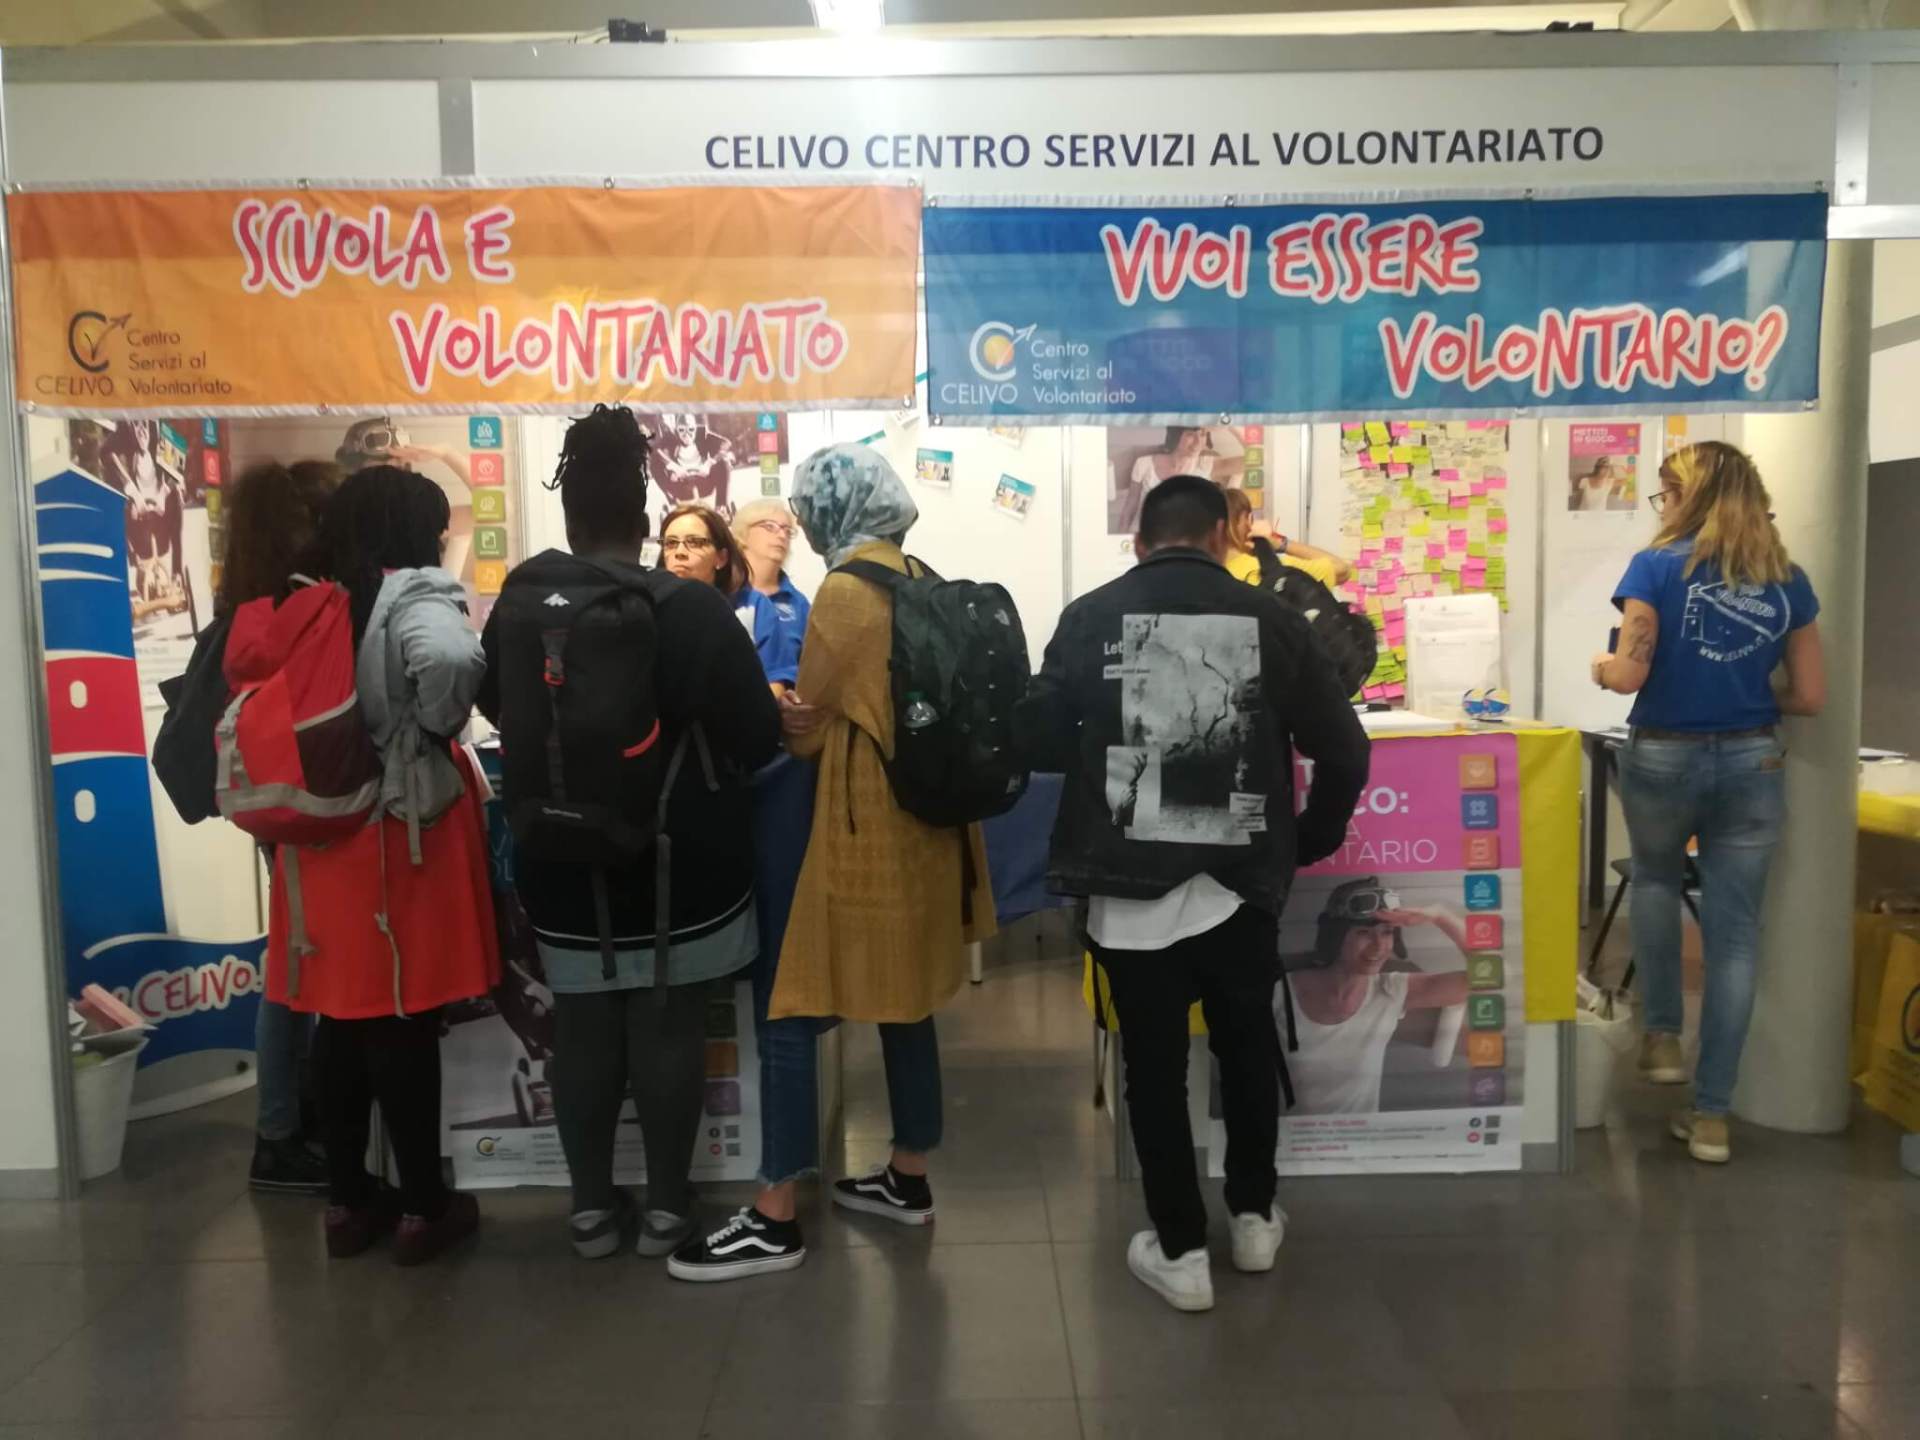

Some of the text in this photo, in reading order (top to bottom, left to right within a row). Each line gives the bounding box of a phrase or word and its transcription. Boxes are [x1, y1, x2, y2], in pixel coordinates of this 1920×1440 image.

[705, 127, 1604, 169] CELIVO CENTRO SERVIZI AL VOLONTARIATO
[236, 201, 512, 294] SCUOLA E
[1102, 215, 1482, 304] VUOI ESSERE
[126, 329, 181, 347] Centro
[392, 301, 845, 391] VOLONTARIATO
[1031, 339, 1089, 358] Centro
[128, 351, 207, 370] Servizi al
[1380, 305, 1786, 396] VOLONTARIO?
[1032, 360, 1113, 380] Servizi al
[35, 375, 114, 396] CELIVO
[128, 376, 233, 395] Volontariato
[941, 383, 1018, 404] CELIVO
[1033, 386, 1136, 404] Volontariato
